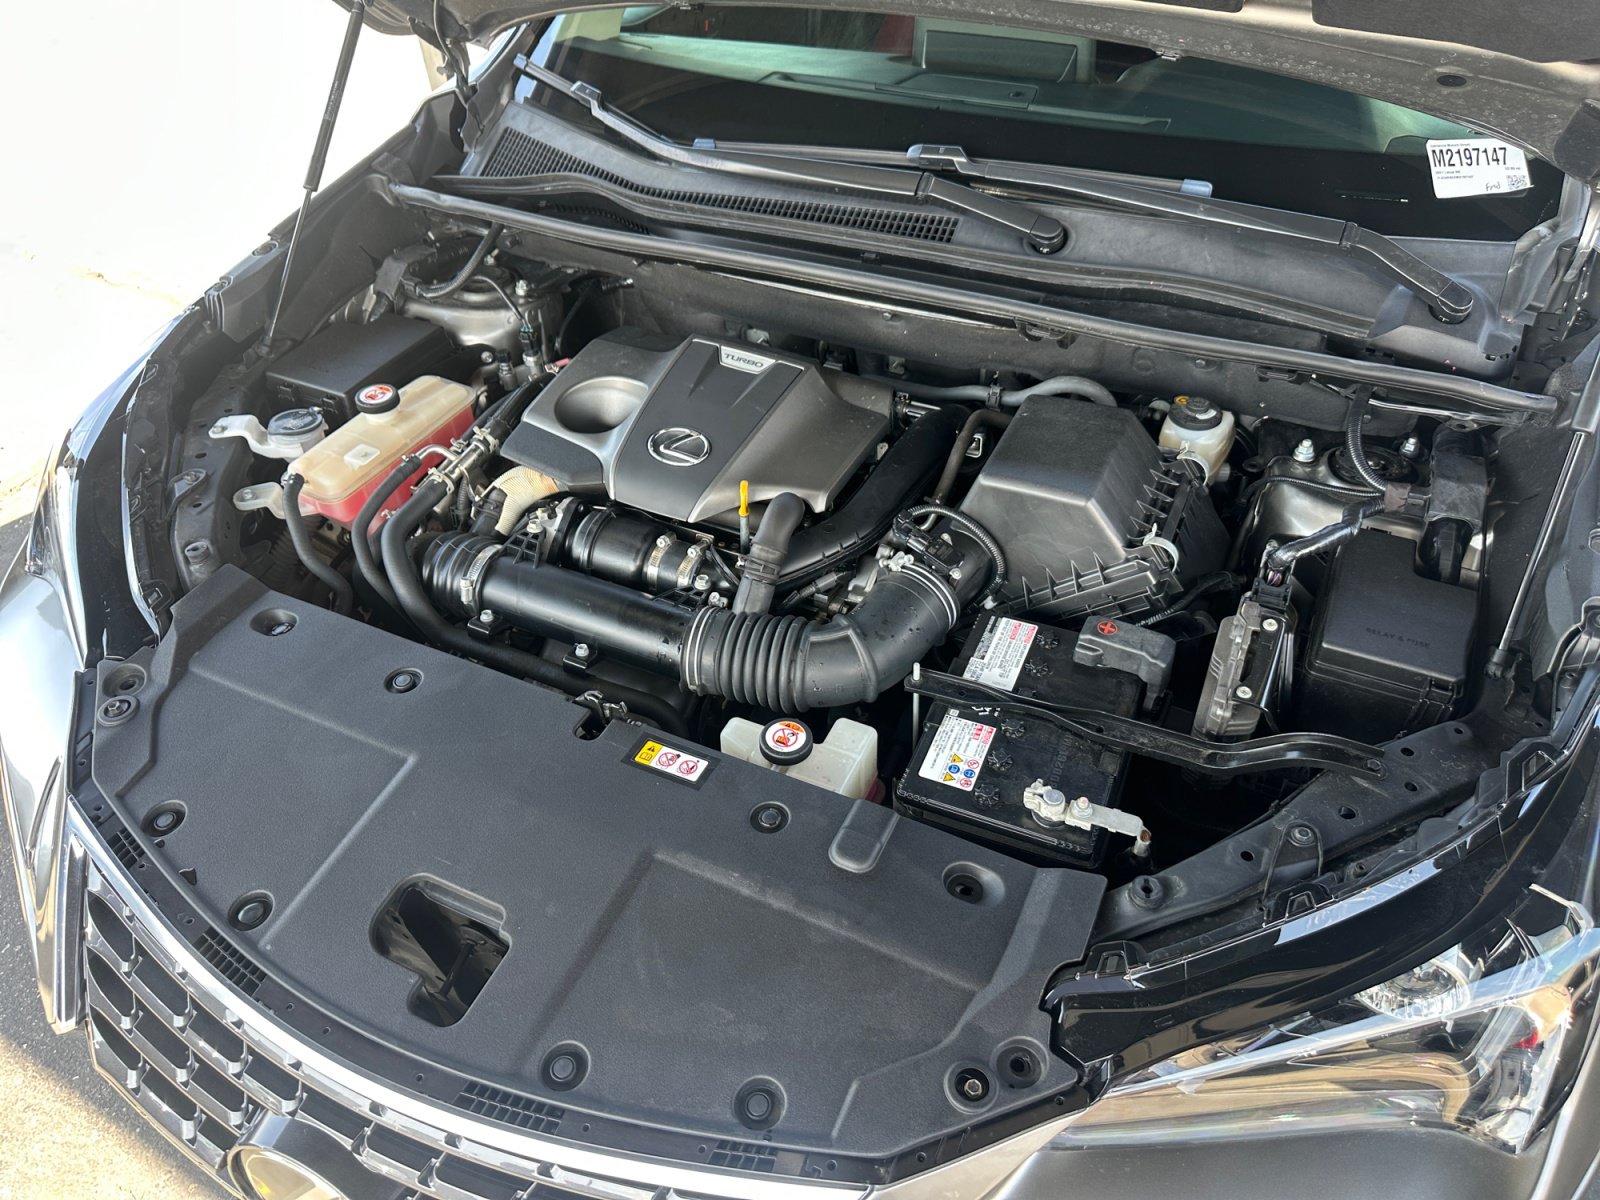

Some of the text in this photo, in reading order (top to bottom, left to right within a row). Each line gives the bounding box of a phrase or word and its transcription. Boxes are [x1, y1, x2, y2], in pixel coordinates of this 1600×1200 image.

[1431, 147, 1508, 168] M2197147
[724, 353, 764, 368] TURBO
[1366, 627, 1396, 639] RELAY
[1406, 638, 1430, 648] FUSE
